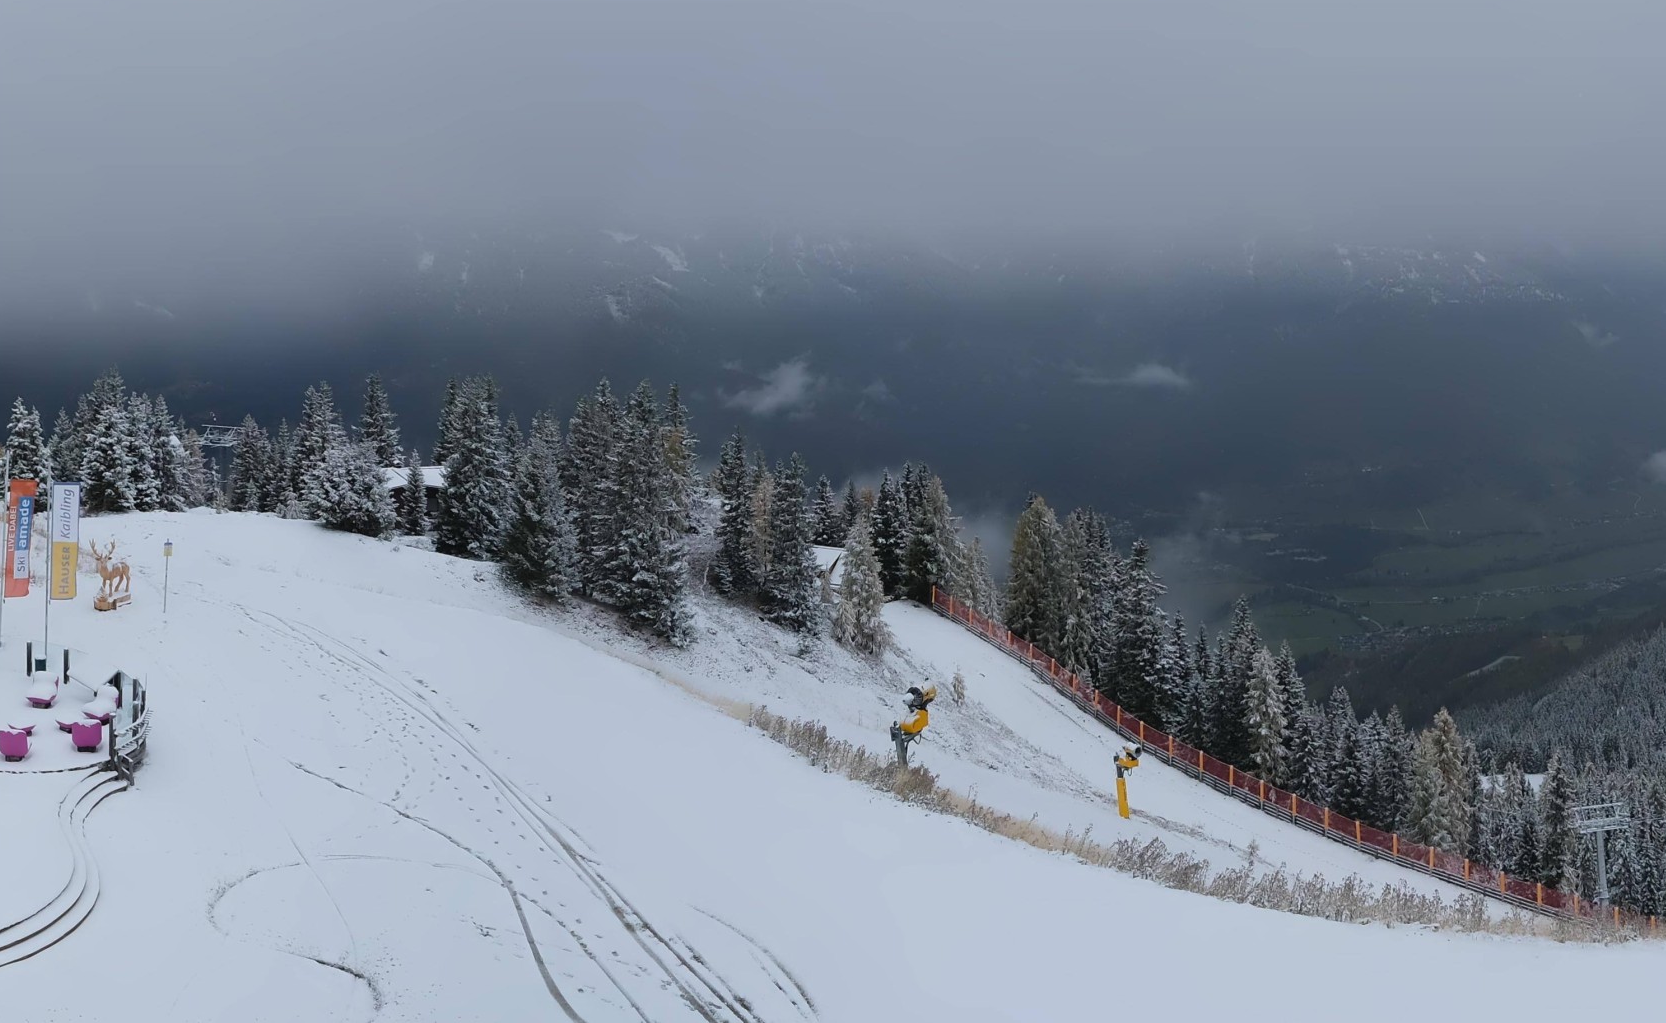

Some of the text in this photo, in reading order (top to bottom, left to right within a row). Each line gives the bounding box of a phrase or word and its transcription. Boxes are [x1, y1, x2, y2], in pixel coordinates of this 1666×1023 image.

[9, 506, 17, 531] DABEI
[59, 489, 75, 595] HAUSER Kaibling
[17, 556, 25, 572] Ski
